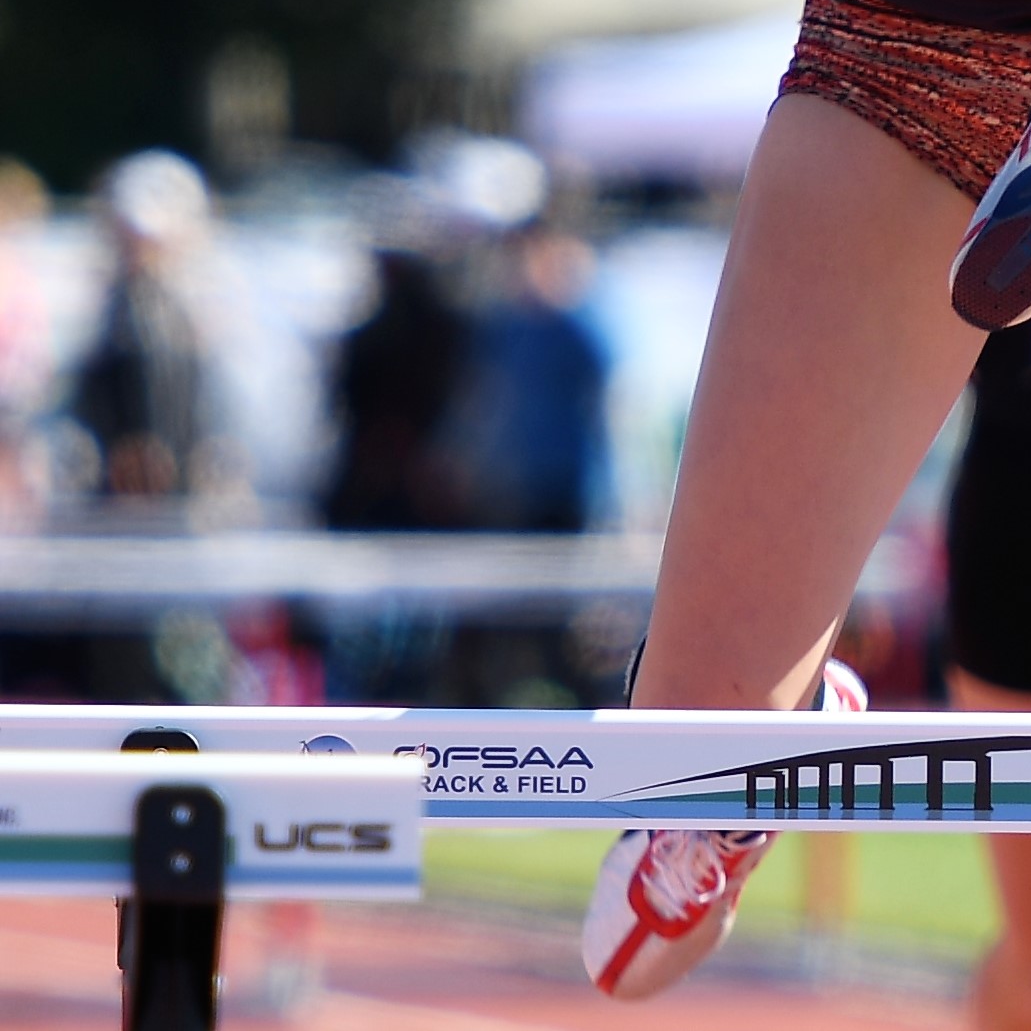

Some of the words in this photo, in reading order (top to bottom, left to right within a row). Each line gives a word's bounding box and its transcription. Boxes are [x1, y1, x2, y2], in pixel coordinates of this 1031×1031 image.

[421, 775, 484, 793] RACK
[493, 775, 509, 793] &
[518, 776, 587, 794] FIELD
[254, 823, 392, 852] UCS
